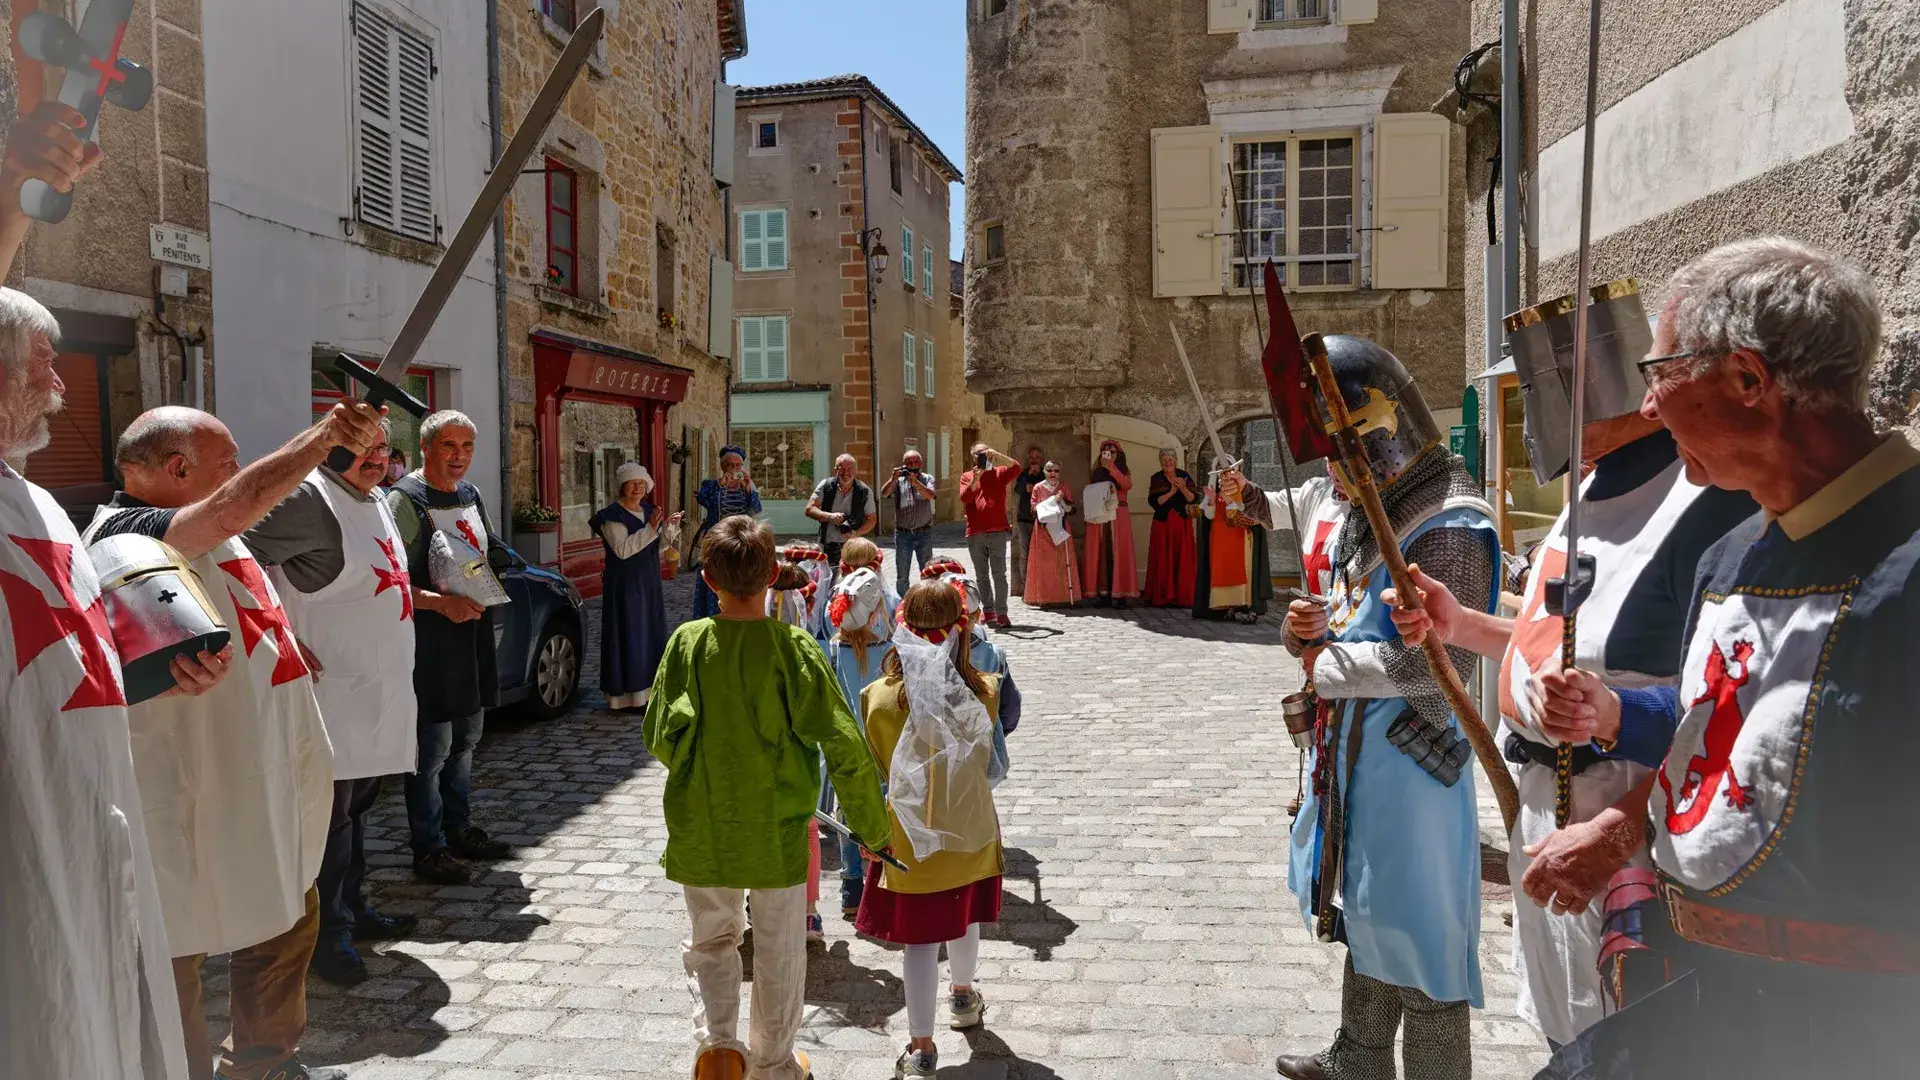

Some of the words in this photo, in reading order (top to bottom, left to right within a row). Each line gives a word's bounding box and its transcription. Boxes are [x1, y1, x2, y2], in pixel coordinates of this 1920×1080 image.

[175, 232, 188, 242] RUE
[162, 247, 201, 264] PÉNITENTS
[595, 366, 670, 395] POTERIE
